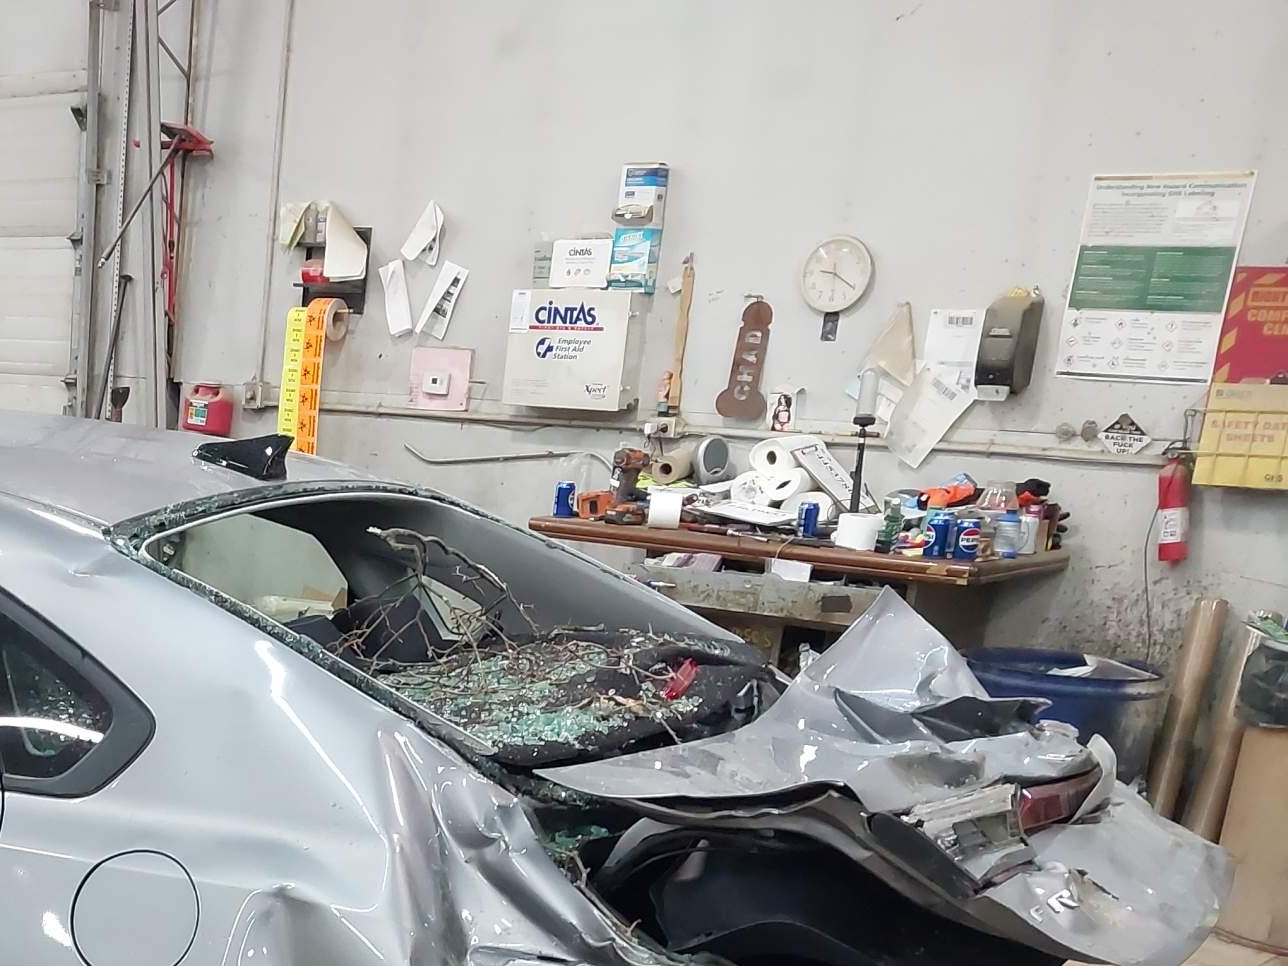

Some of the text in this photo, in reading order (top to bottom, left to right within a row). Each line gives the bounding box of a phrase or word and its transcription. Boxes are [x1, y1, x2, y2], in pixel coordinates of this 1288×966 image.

[534, 300, 597, 326] CINTAS
[558, 337, 592, 347] Employee
[555, 345, 585, 353] First Aid
